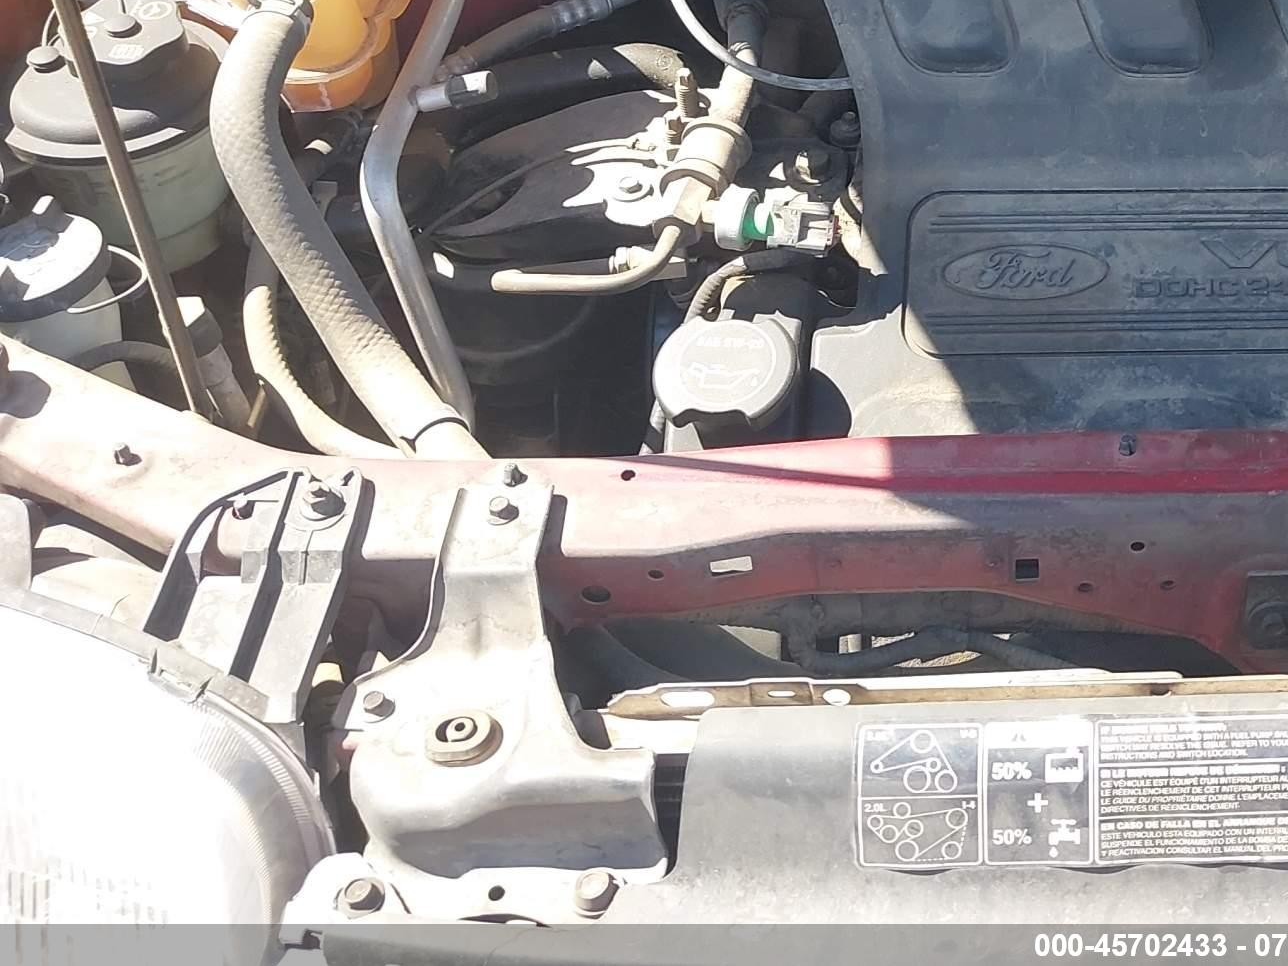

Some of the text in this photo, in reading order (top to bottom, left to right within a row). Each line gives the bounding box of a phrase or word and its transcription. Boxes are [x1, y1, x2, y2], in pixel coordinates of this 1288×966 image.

[976, 249, 1077, 289] Ford
[1134, 277, 1240, 298] DOHC
[991, 761, 1032, 780] 50%
[864, 803, 888, 813] 2.0L
[992, 828, 1032, 845] 50%
